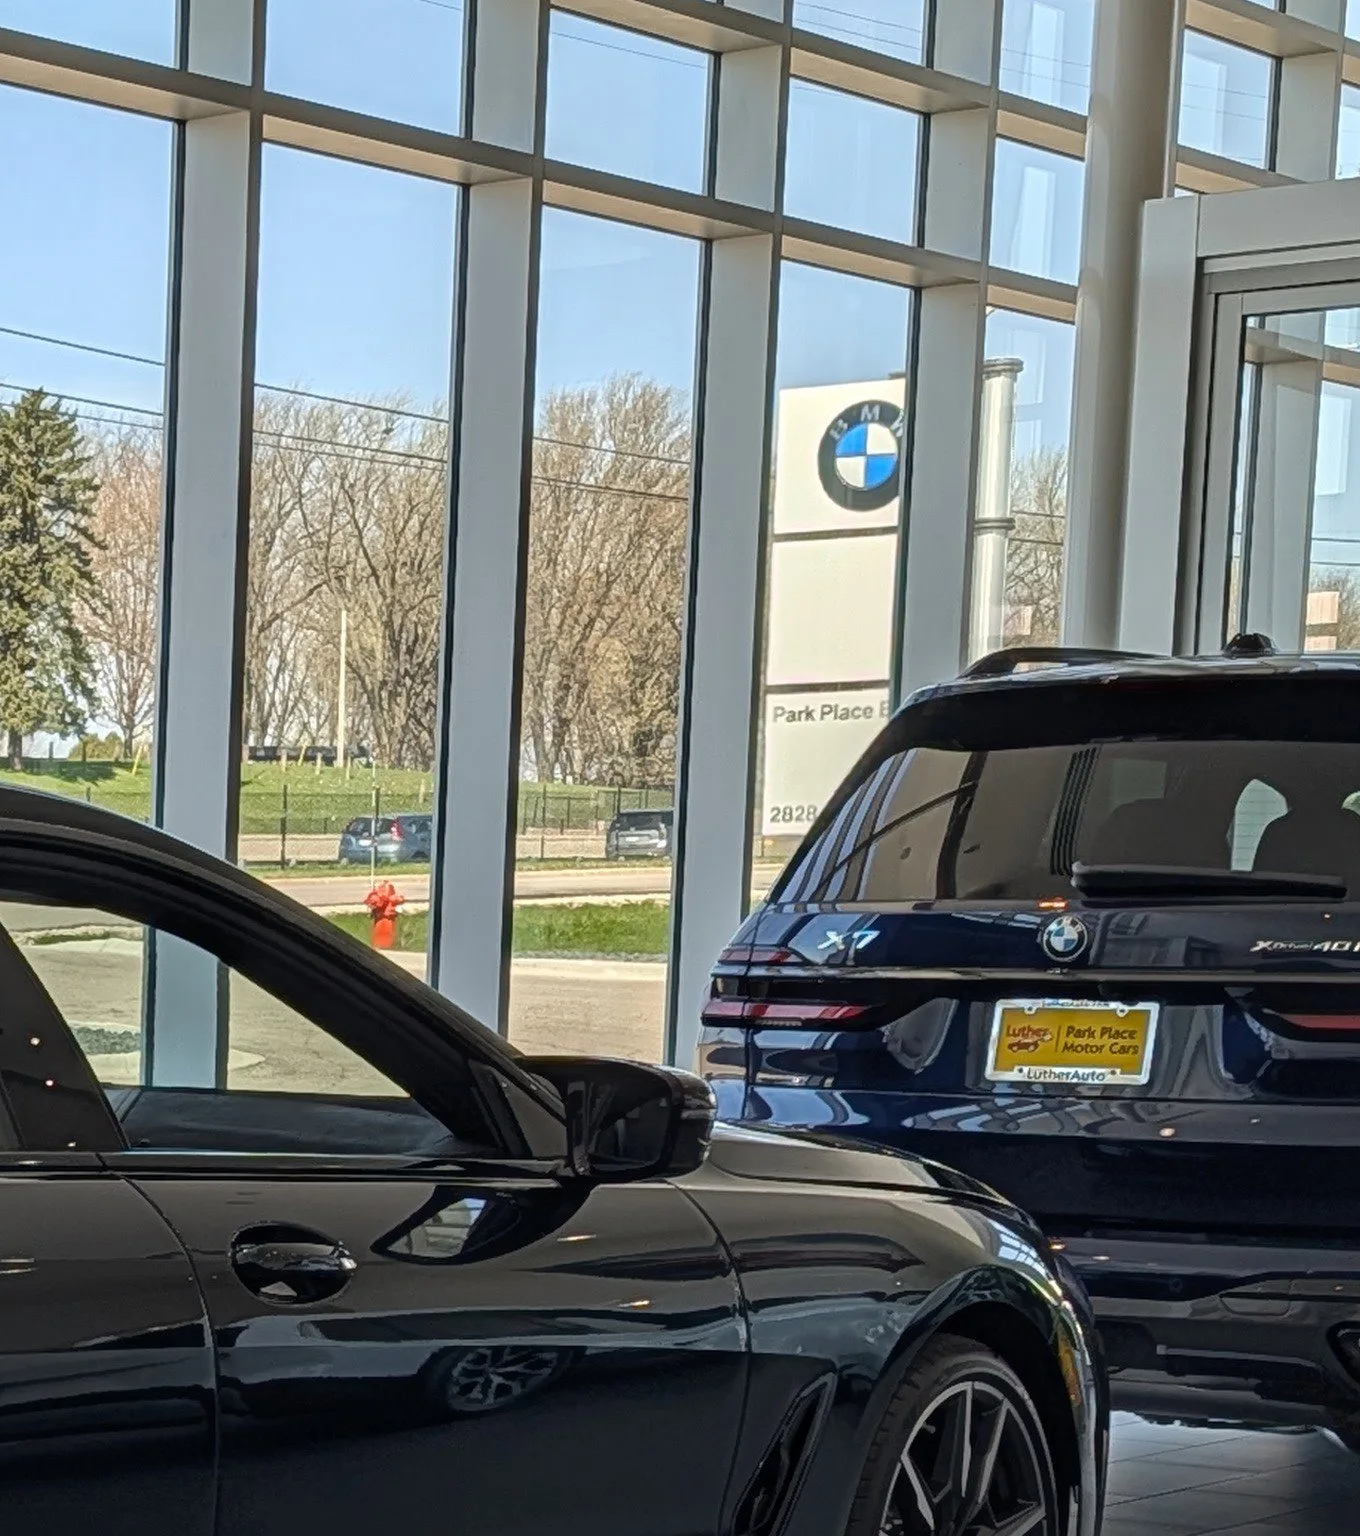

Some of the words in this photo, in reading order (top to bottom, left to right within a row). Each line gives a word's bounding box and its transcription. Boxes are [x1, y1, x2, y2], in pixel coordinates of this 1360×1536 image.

[773, 705, 815, 722] Park
[820, 703, 874, 720] Place
[770, 804, 818, 823] 2828
[817, 929, 881, 950] X7
[1006, 1024, 1050, 1039] Luther
[1066, 1026, 1096, 1040] Park
[1100, 1026, 1138, 1040] Place
[1062, 1042, 1105, 1054] Motor
[1109, 1043, 1140, 1055] Cars
[1027, 1068, 1107, 1082] LutherAuto
